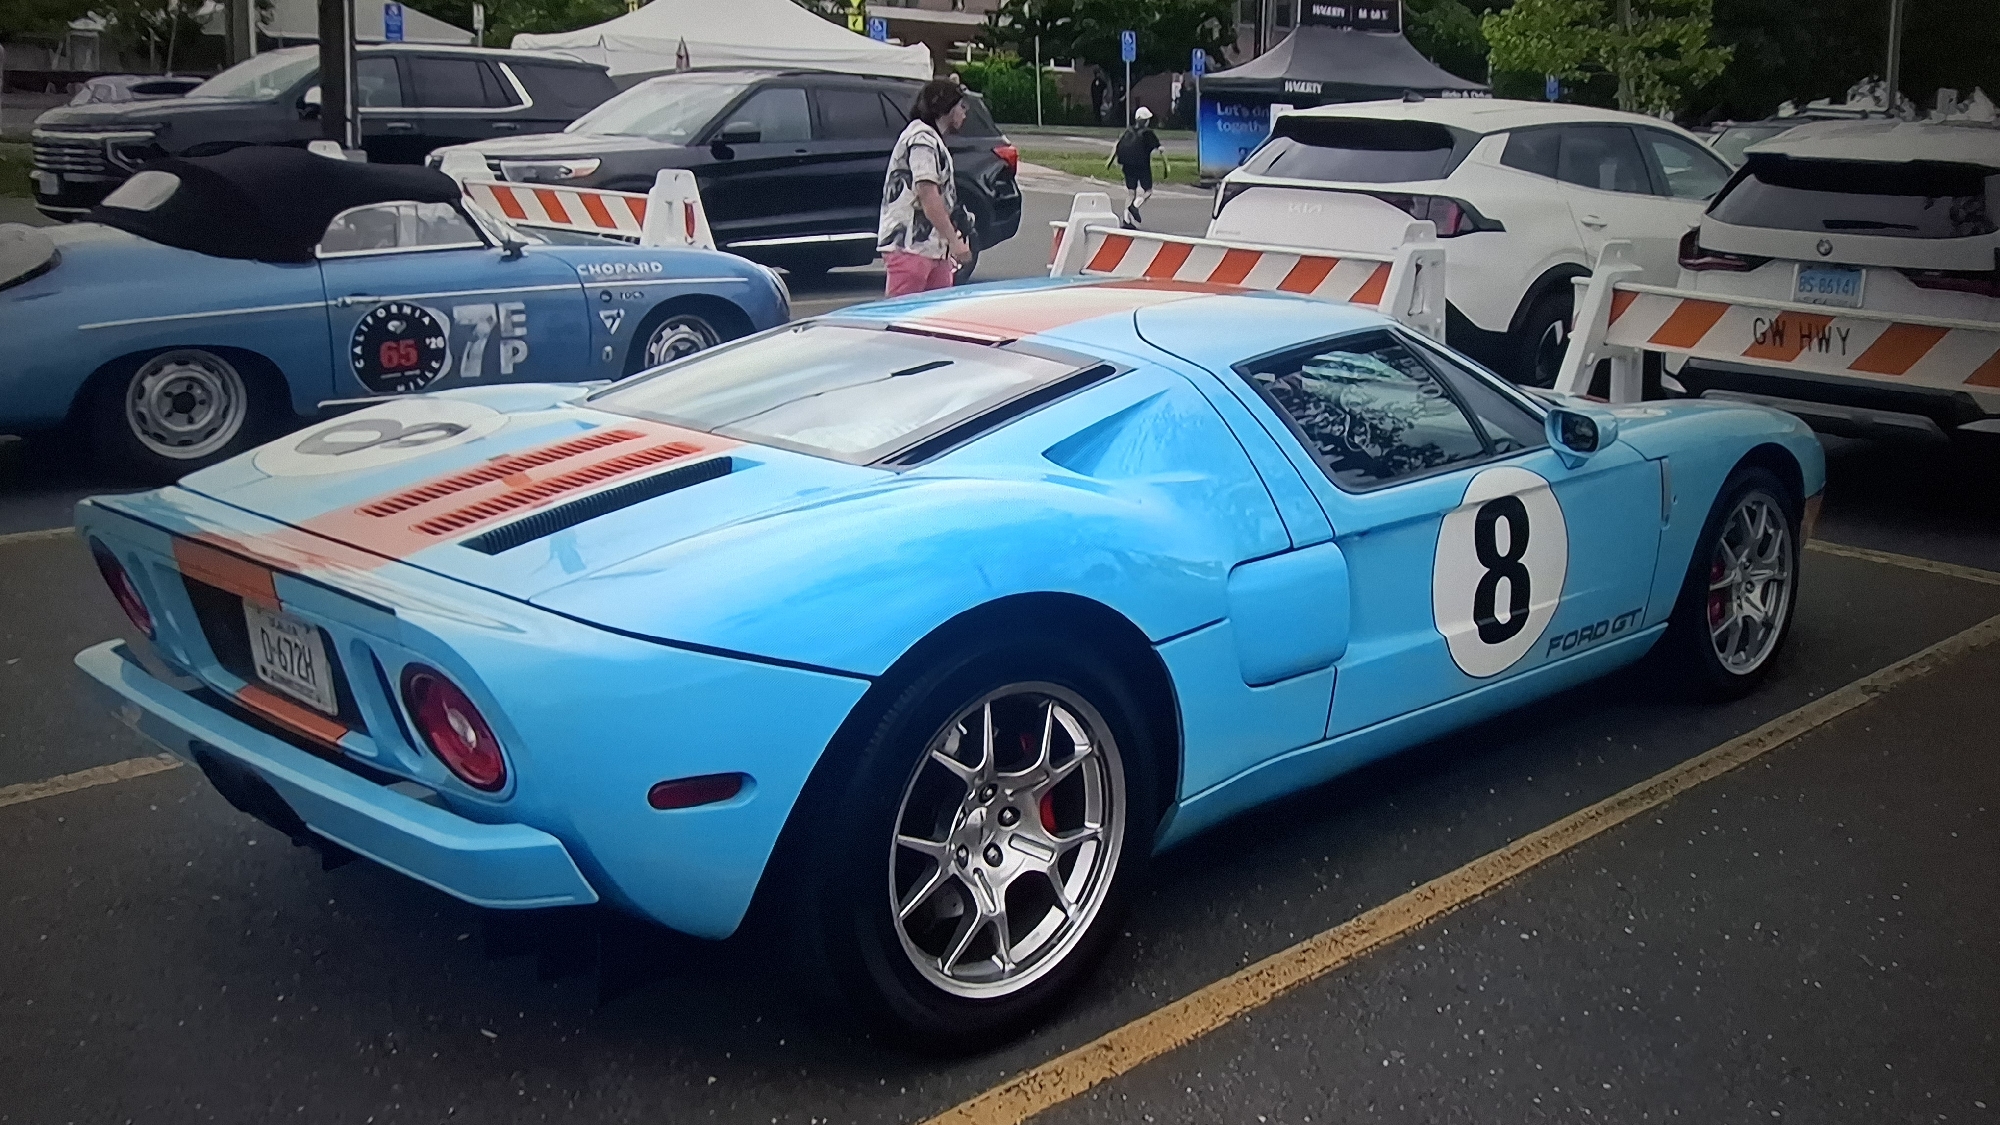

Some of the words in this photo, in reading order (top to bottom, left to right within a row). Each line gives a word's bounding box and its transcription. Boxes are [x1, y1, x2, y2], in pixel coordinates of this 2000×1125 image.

[576, 262, 663, 275] CHOPARD
[353, 304, 431, 368] CALIFORNIA
[379, 339, 418, 368] 65
[453, 303, 497, 377] 7
[1753, 317, 1786, 348] GW
[1799, 321, 1850, 356] HWY
[294, 418, 473, 457] 8
[1473, 495, 1531, 645] 8
[1546, 619, 1609, 658] FORD
[1611, 606, 1644, 635] GT
